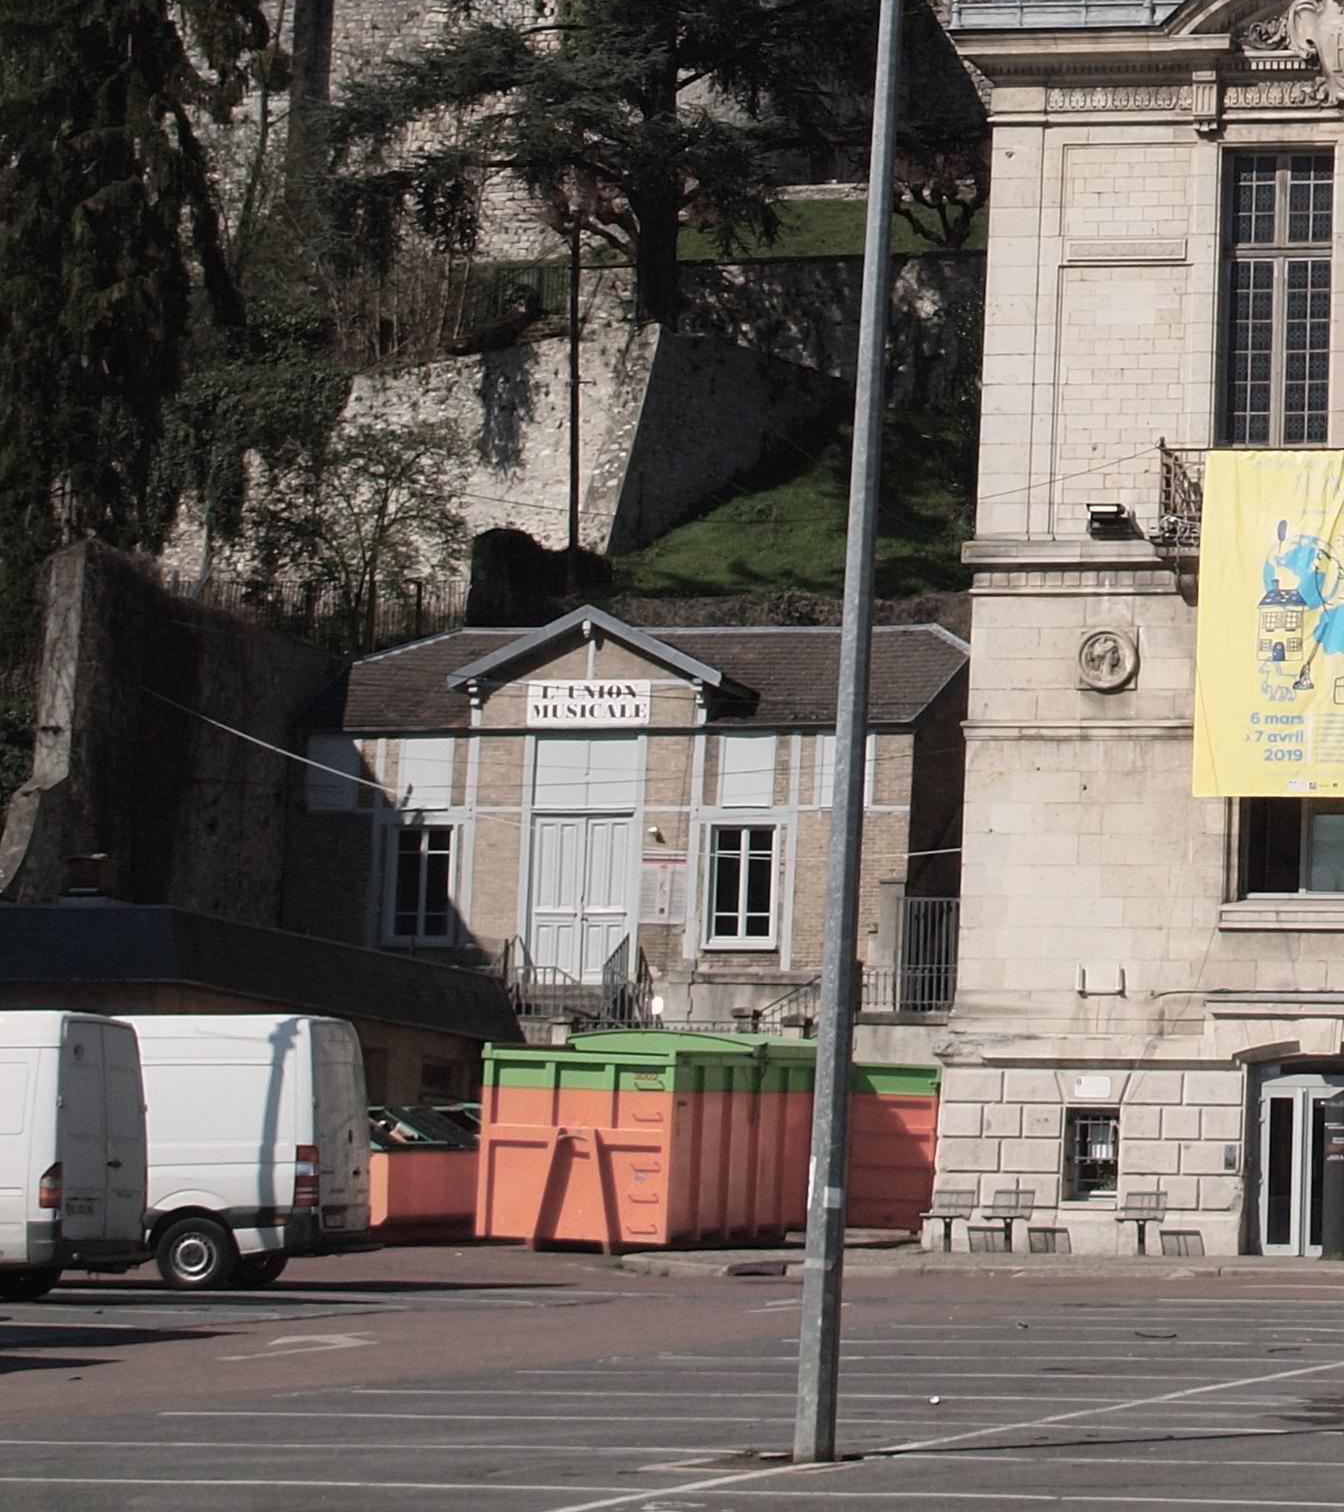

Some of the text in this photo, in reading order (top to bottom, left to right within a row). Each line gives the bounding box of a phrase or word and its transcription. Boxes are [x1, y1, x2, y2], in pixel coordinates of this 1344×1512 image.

[568, 684, 638, 700] UNION
[532, 702, 647, 720] MUSICALE
[1251, 712, 1304, 725] 6 mars
[1254, 730, 1304, 743] 7 avril
[1264, 748, 1303, 762] 2019
